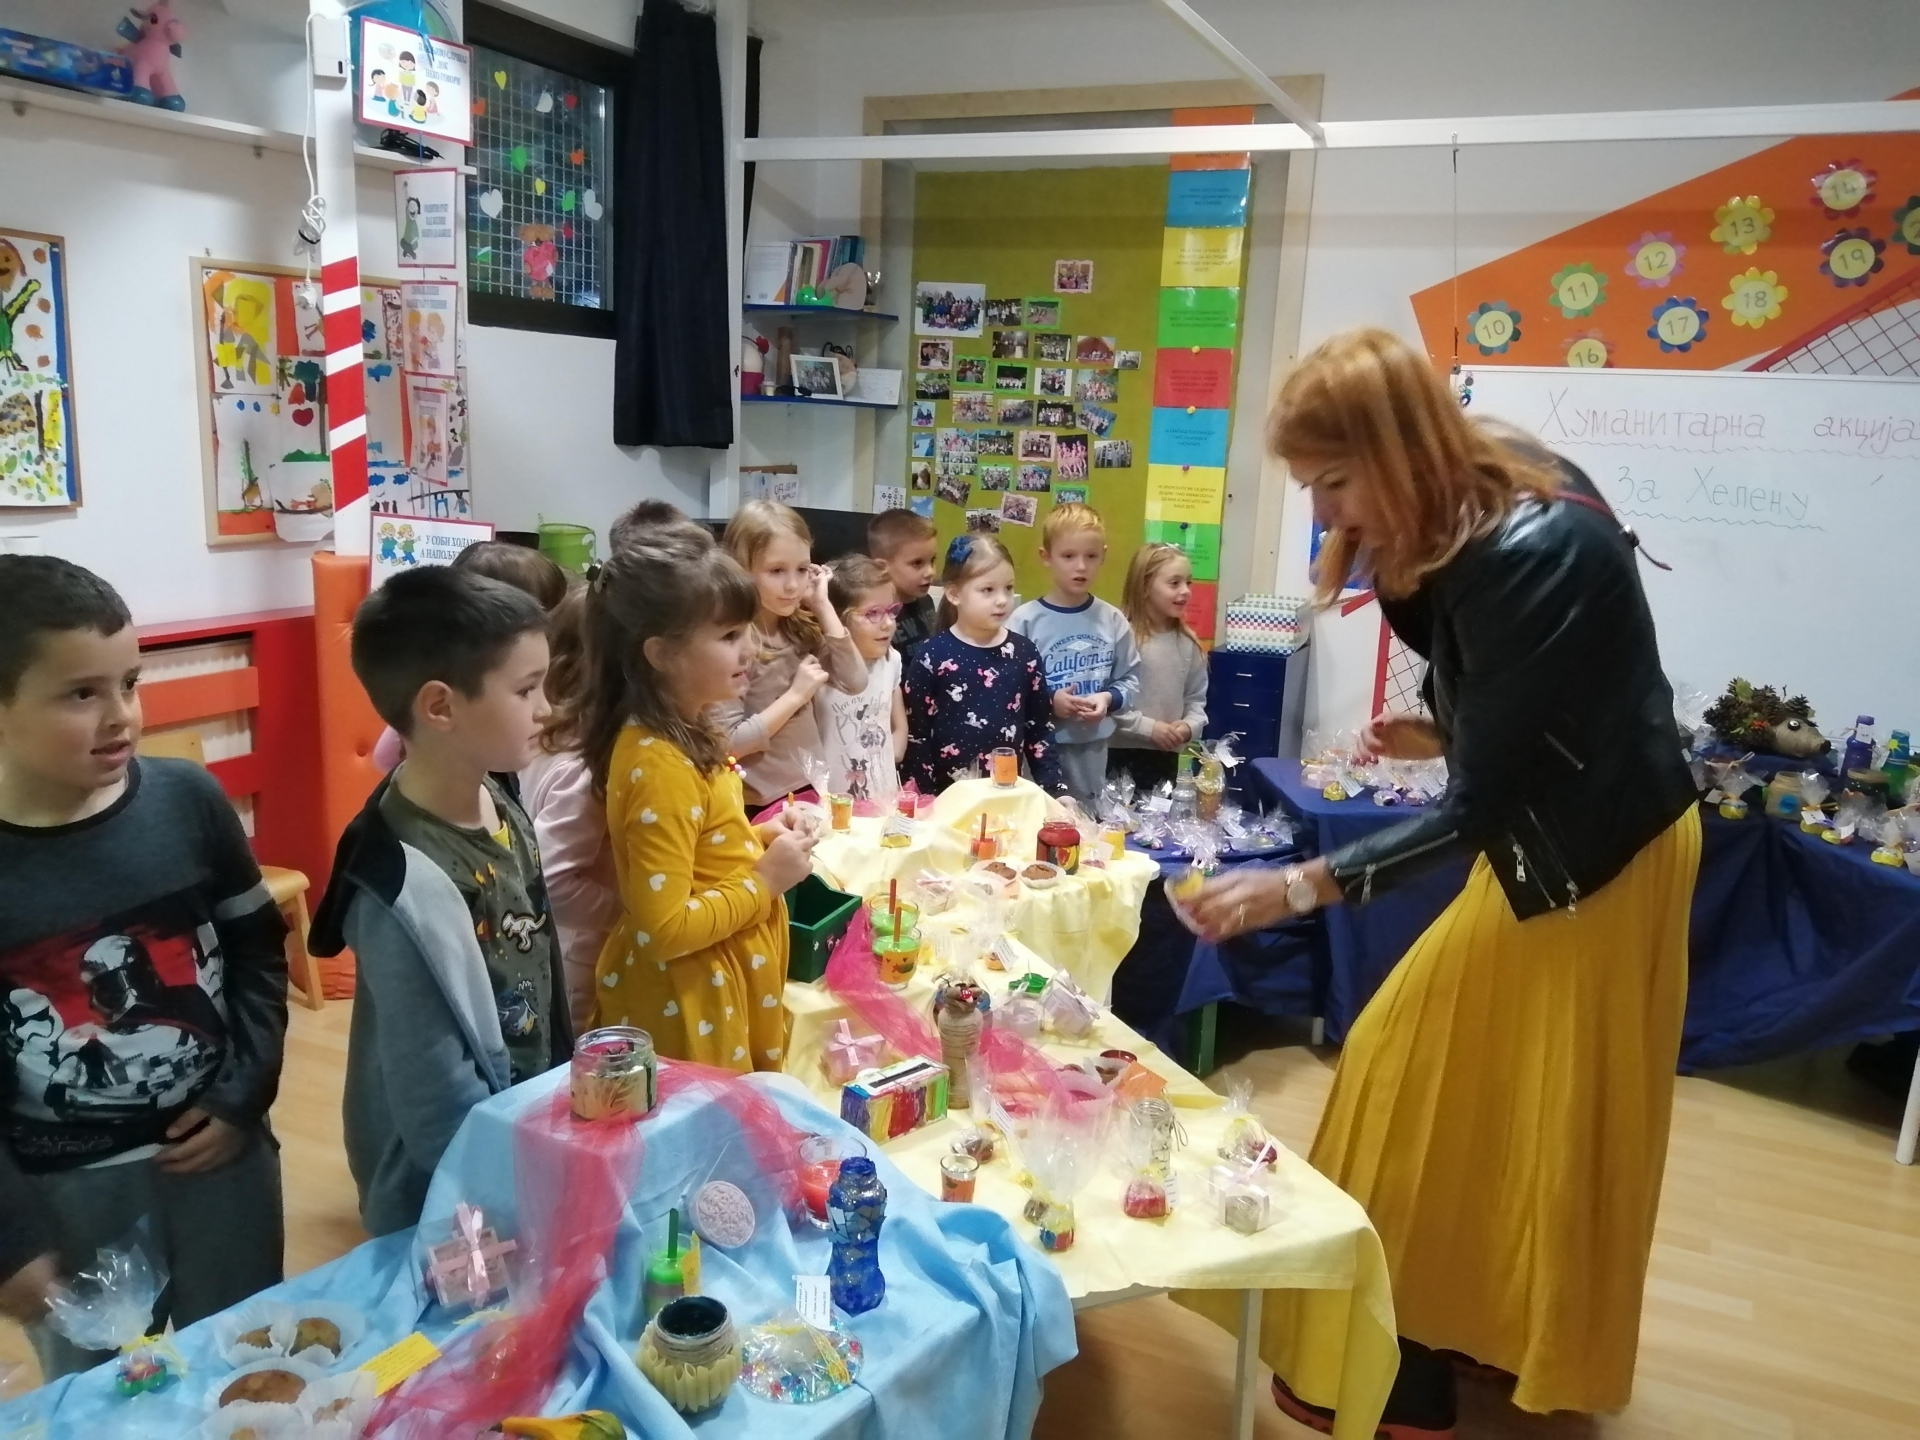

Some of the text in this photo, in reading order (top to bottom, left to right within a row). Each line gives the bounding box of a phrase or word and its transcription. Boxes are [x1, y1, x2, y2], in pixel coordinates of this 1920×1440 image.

[1830, 183, 1859, 201] 14
[1730, 217, 1756, 238] 13
[1643, 251, 1670, 272] 12
[1838, 248, 1867, 271] 19
[1567, 280, 1590, 302] 11
[1743, 290, 1767, 309] 18
[1481, 318, 1507, 338] 10
[1666, 316, 1690, 336] 17
[1575, 347, 1600, 367] 16
[1539, 387, 1920, 453] Хуманитарна акција
[1686, 466, 1809, 520] Хелену
[1049, 634, 1108, 652] FINEST QUALITY
[1044, 650, 1114, 676] California
